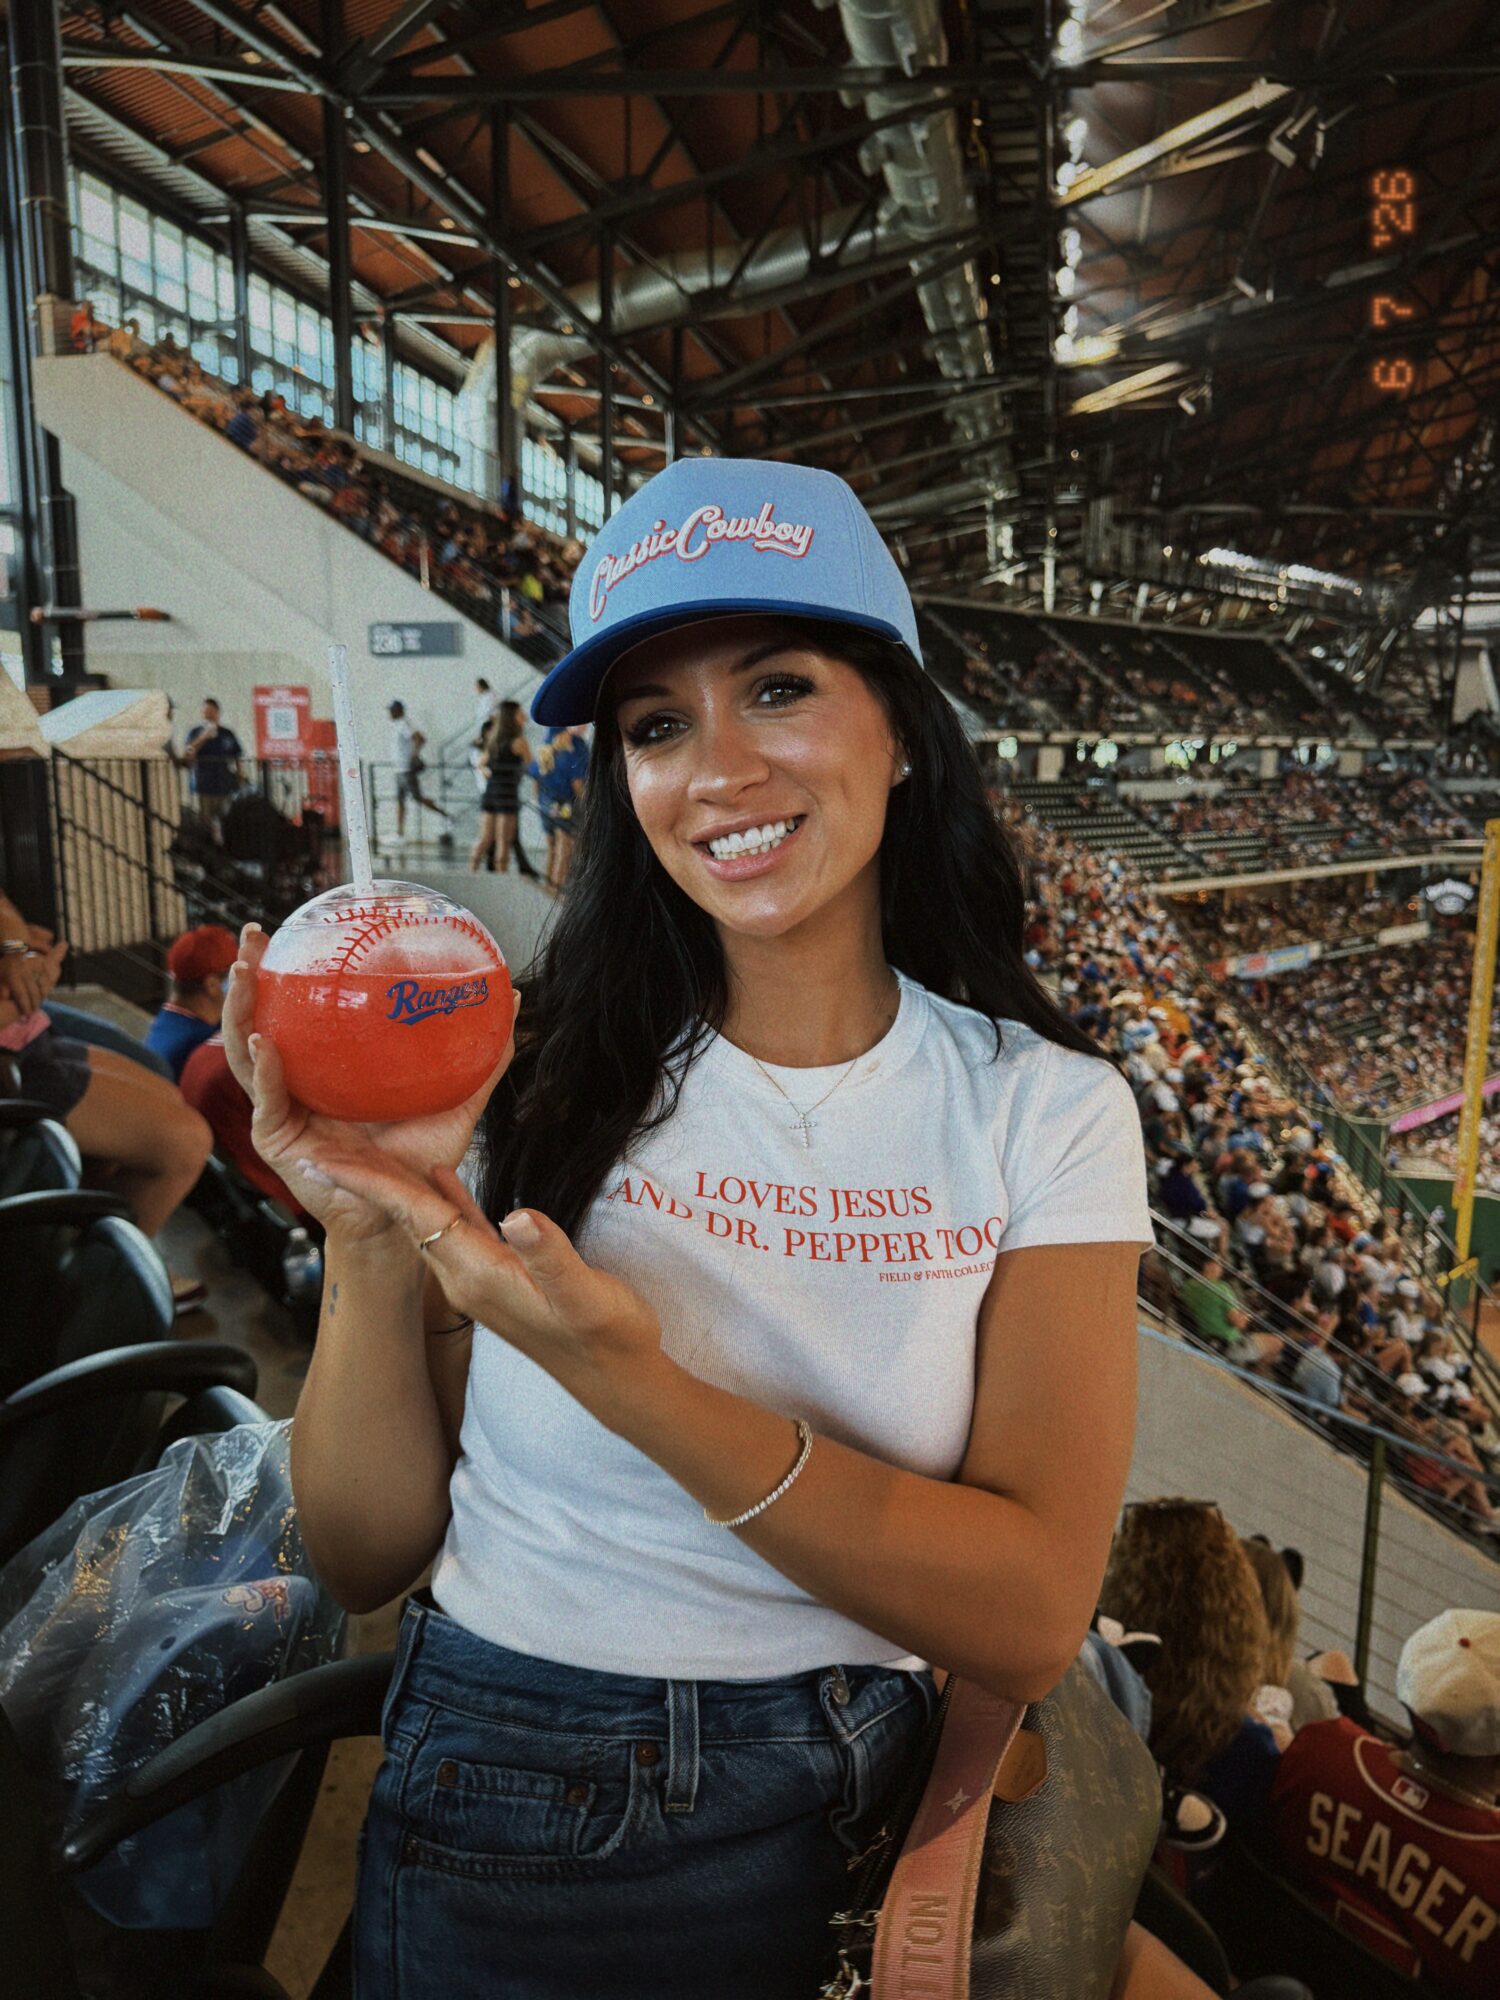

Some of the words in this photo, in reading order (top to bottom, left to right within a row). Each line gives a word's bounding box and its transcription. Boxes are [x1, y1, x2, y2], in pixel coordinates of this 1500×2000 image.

[675, 502, 814, 563] Cowboy
[387, 977, 489, 1025] Rangers
[606, 1177, 693, 1219] AND
[705, 1210, 769, 1251] DR.
[783, 1228, 934, 1263] PEPPER
[694, 1171, 818, 1217] LOVES
[829, 1186, 933, 1223] JESUS
[879, 1272, 911, 1282] FIELD
[913, 1271, 923, 1281] &
[925, 1269, 953, 1280] FAITH
[1306, 1791, 1498, 1963] SEAGER
